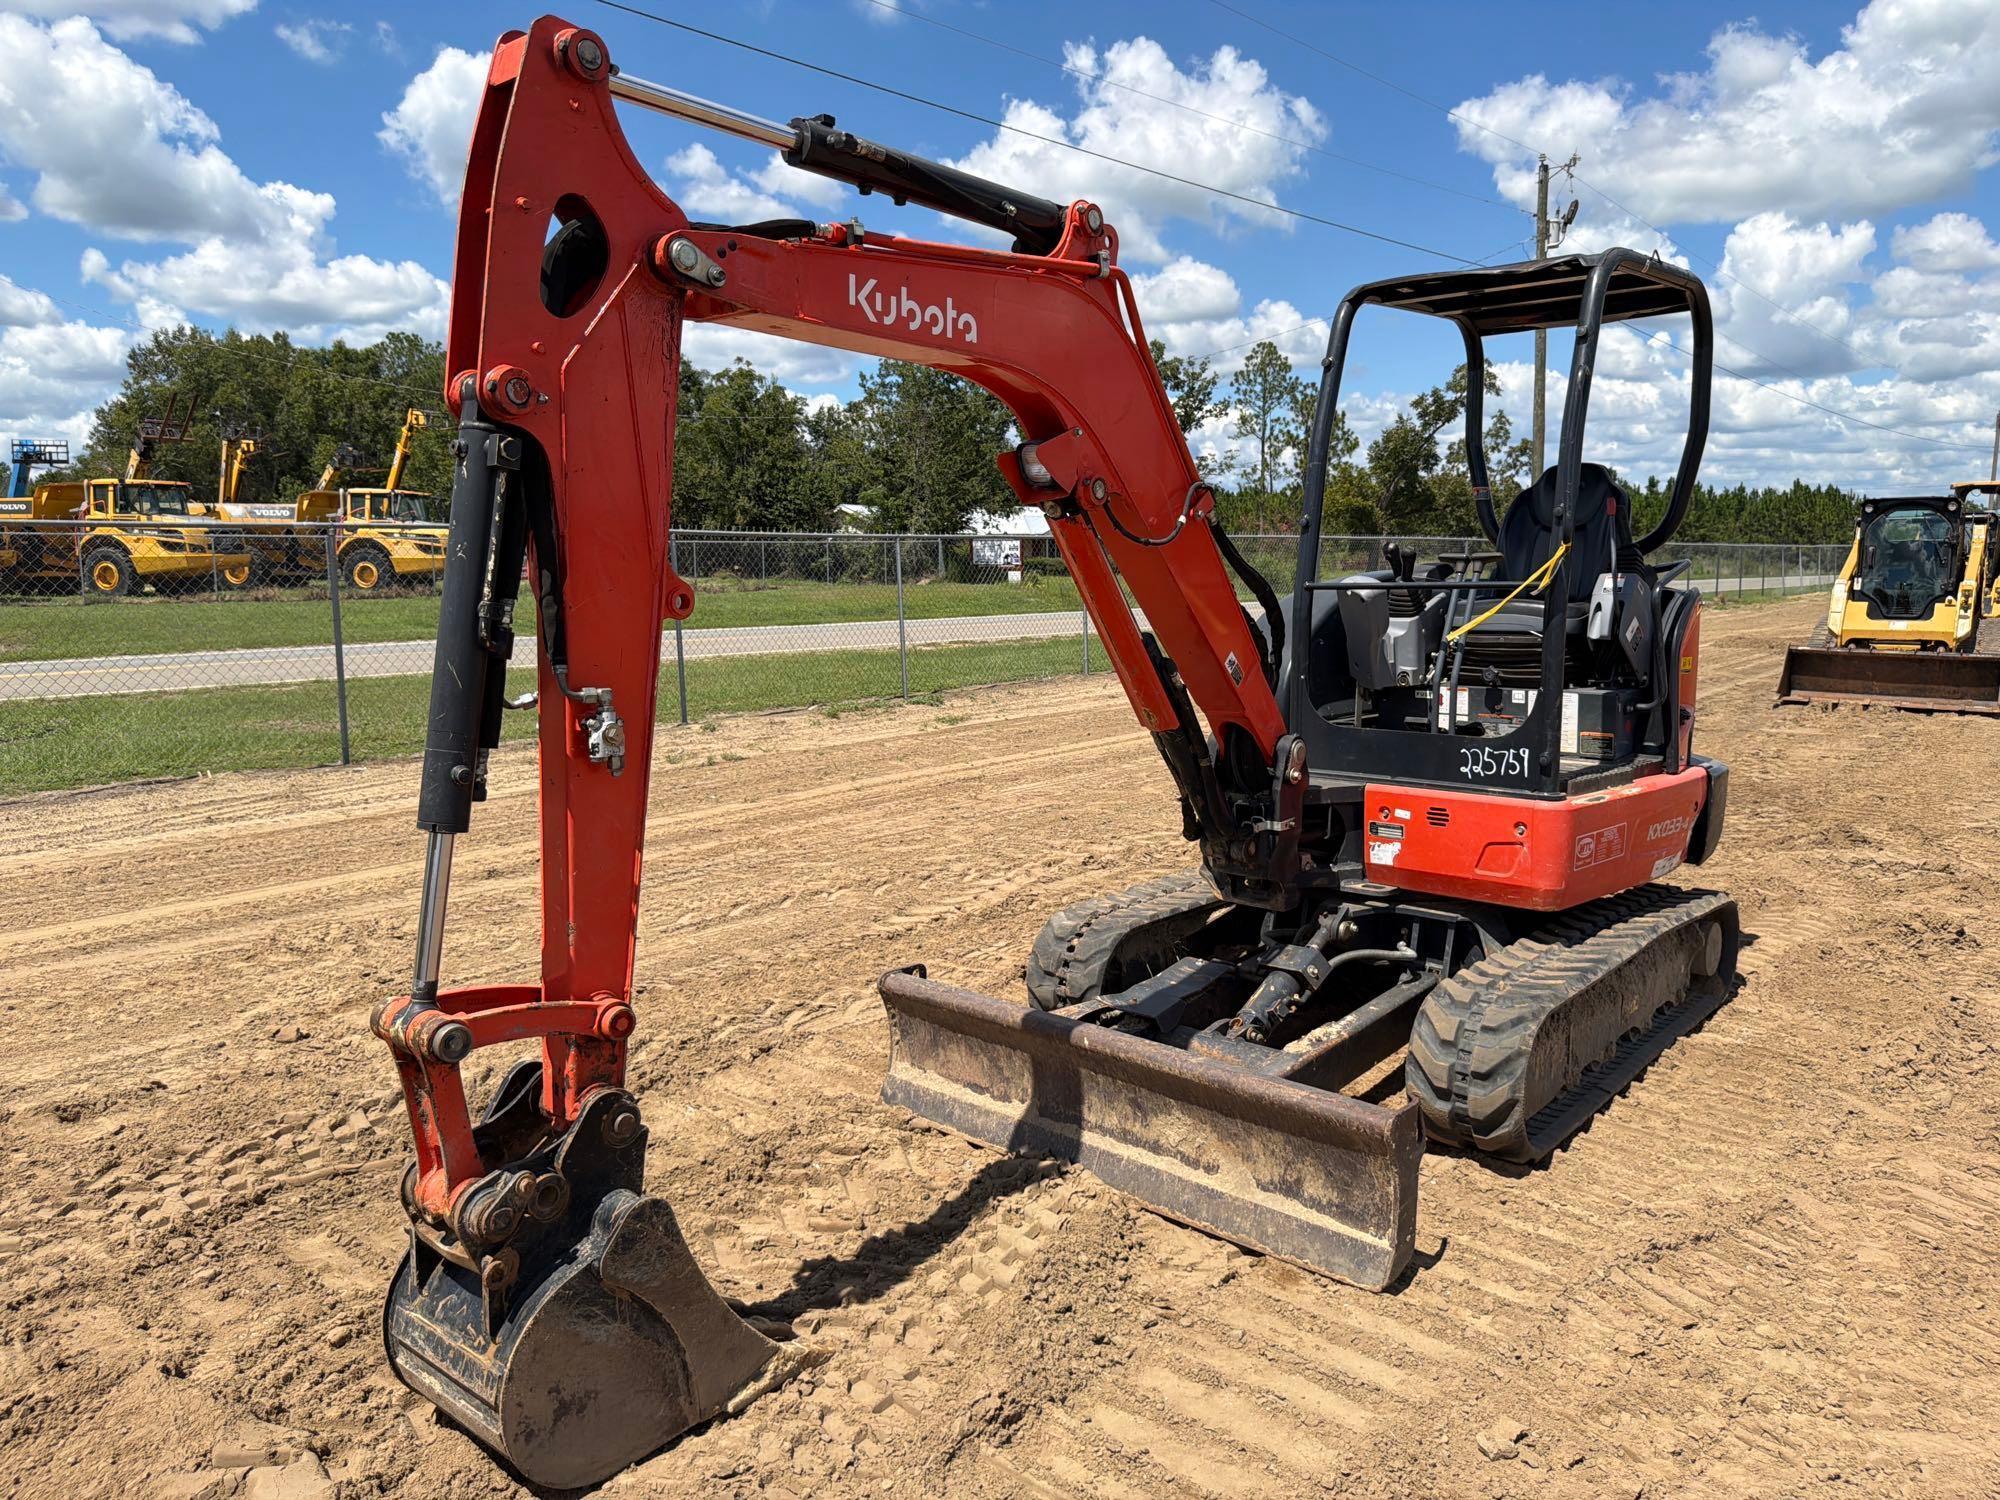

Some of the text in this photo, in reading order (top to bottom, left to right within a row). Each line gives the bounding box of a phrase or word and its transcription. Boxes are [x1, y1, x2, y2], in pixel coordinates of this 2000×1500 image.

[849, 273, 978, 344] Kubota
[254, 508, 290, 517] VOLVO
[1459, 746, 1530, 780] 225759
[1647, 816, 1690, 841] KX033-4
